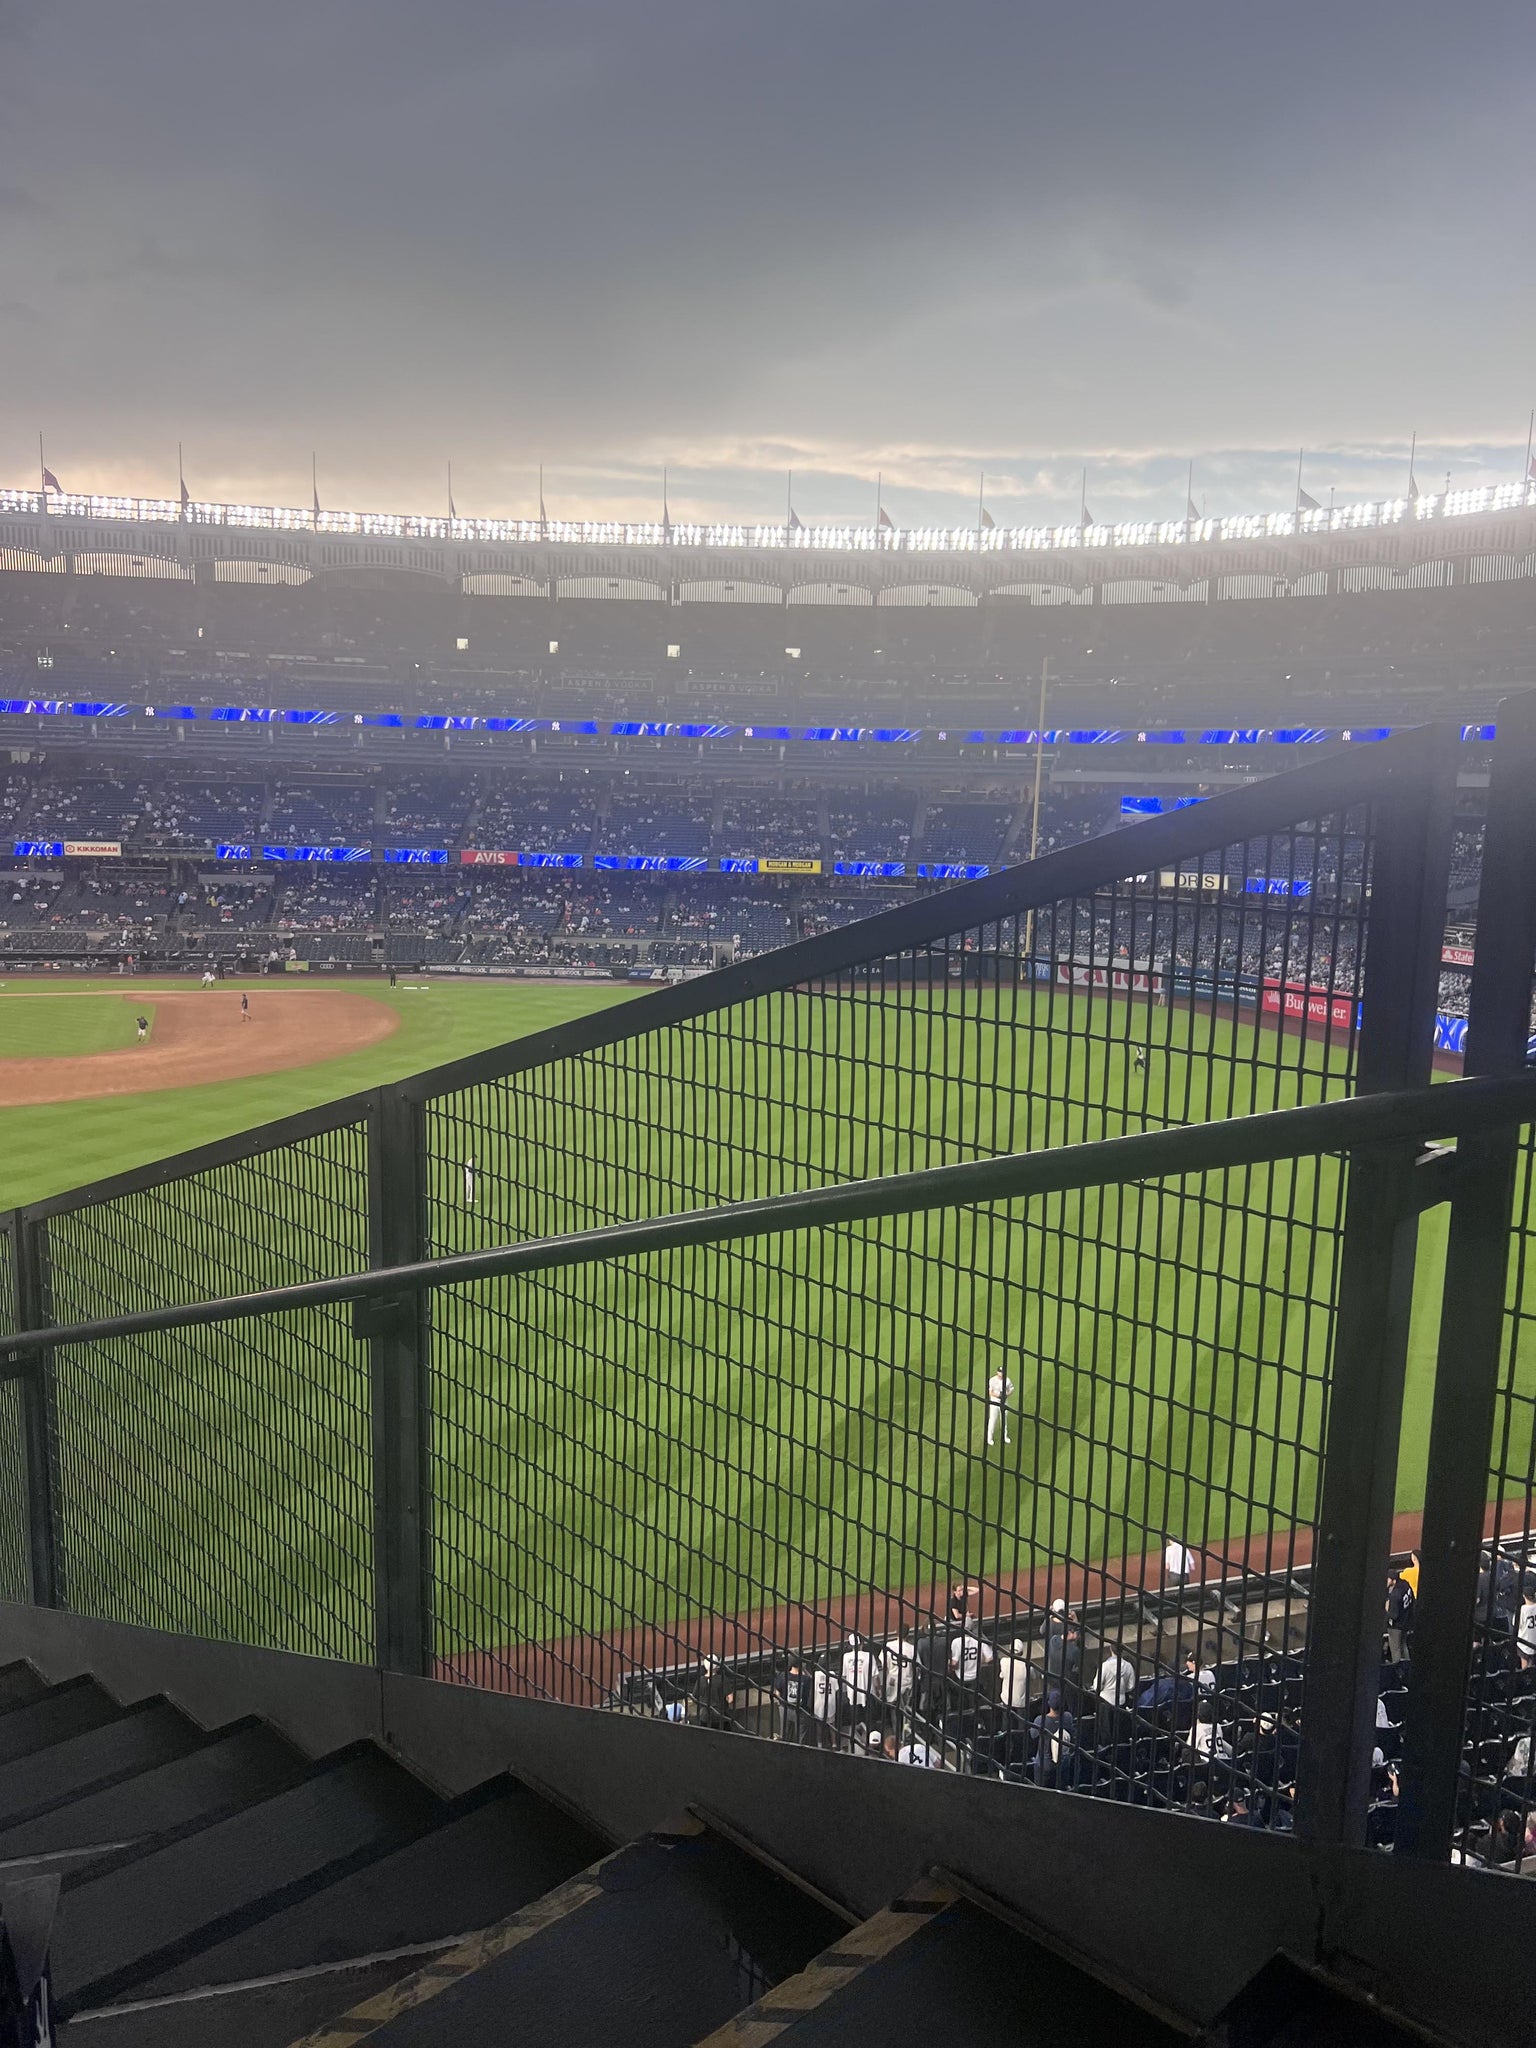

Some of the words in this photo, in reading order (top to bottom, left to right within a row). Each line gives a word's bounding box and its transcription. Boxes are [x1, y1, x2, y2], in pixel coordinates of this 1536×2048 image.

[474, 853, 506, 864] AVIS
[1174, 873, 1216, 888] ORS
[1453, 951, 1473, 963] State
[1285, 993, 1347, 1020] Buweier
